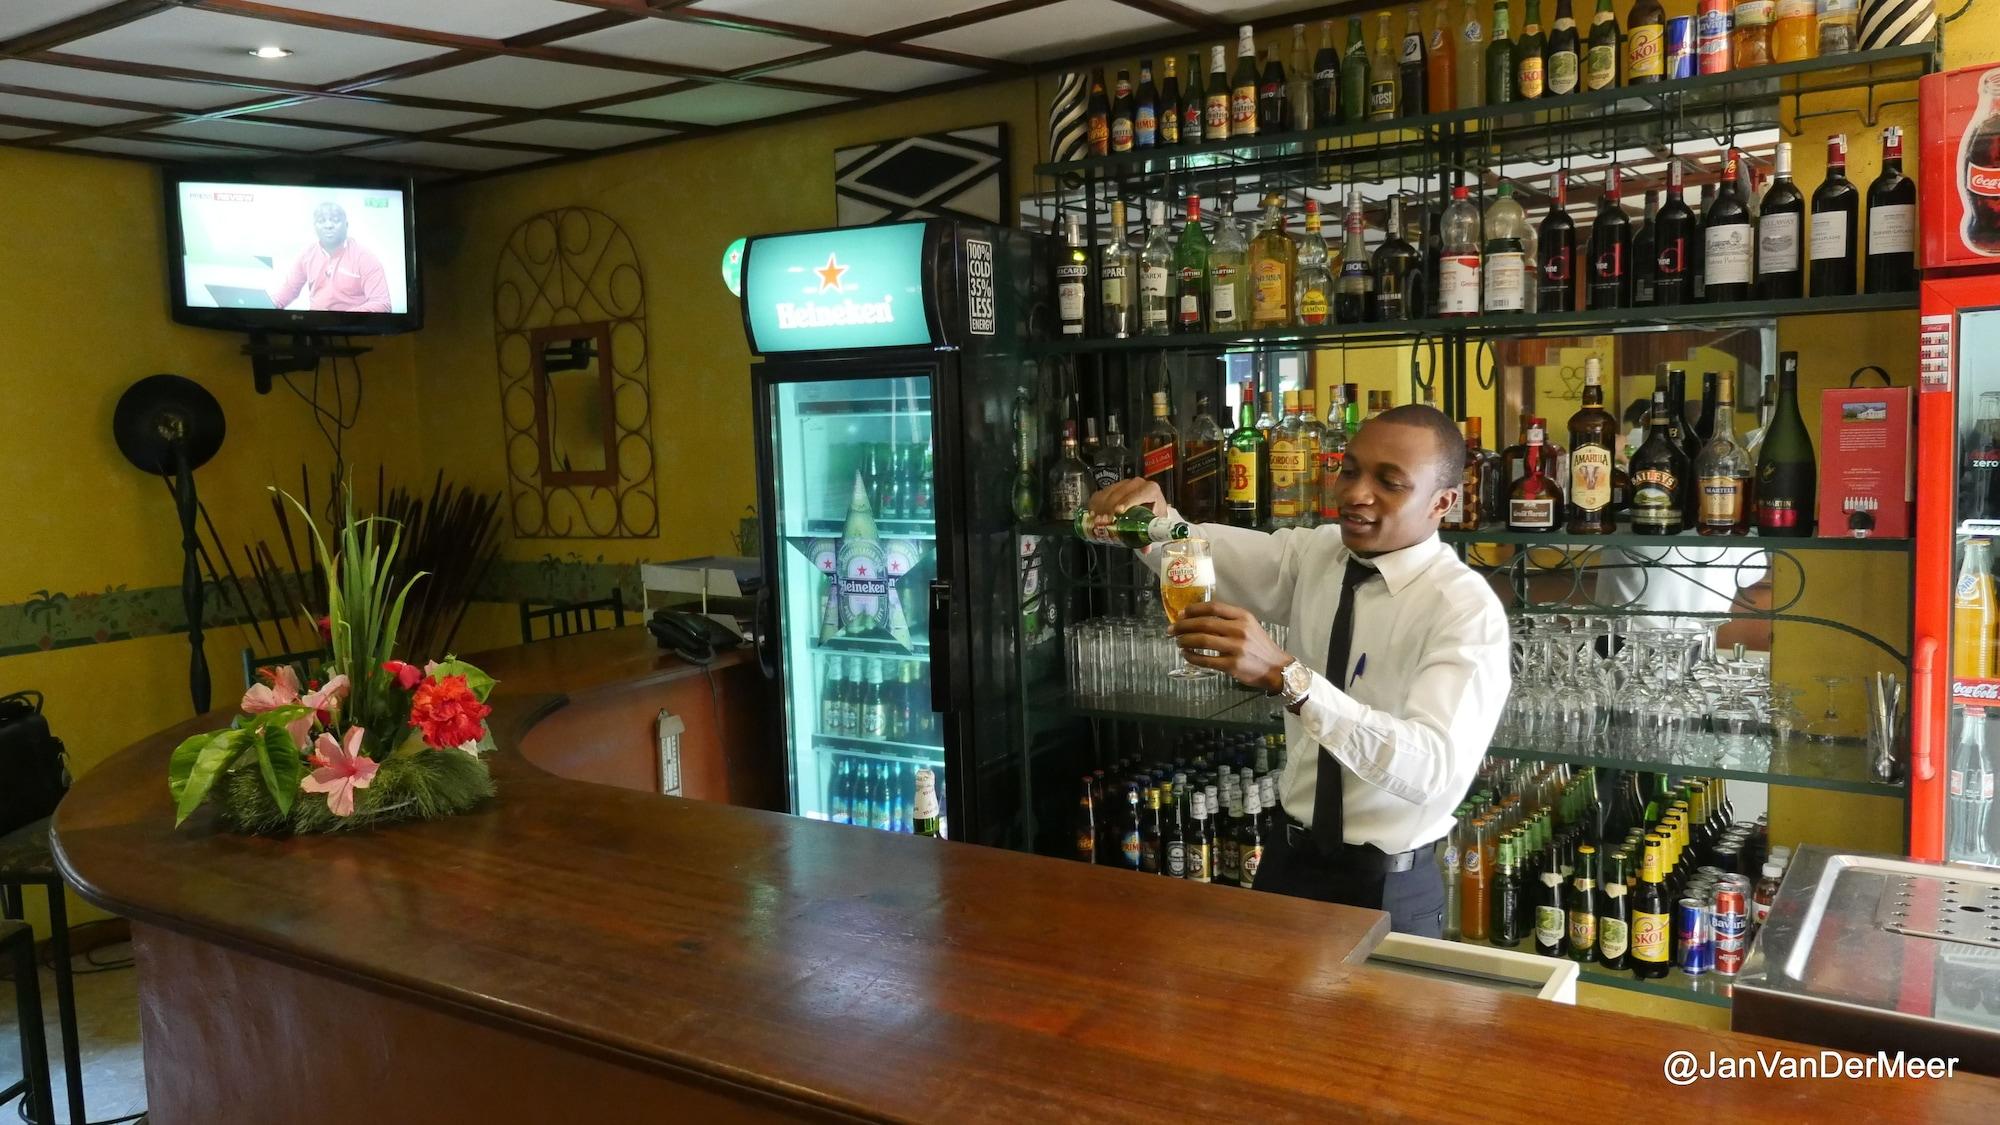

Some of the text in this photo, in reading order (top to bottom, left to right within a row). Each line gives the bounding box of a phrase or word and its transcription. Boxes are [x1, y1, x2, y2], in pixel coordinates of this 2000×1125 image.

[969, 243, 990, 261] 100%
[969, 260, 991, 278] COLD
[970, 278, 992, 298] 35%
[776, 299, 894, 329] Heineken
[971, 298, 992, 318] LESS
[972, 318, 993, 331] ENERGY
[1972, 458, 1999, 468] zero
[840, 578, 886, 595] Heineken
[1634, 931, 1665, 944] SKOL
